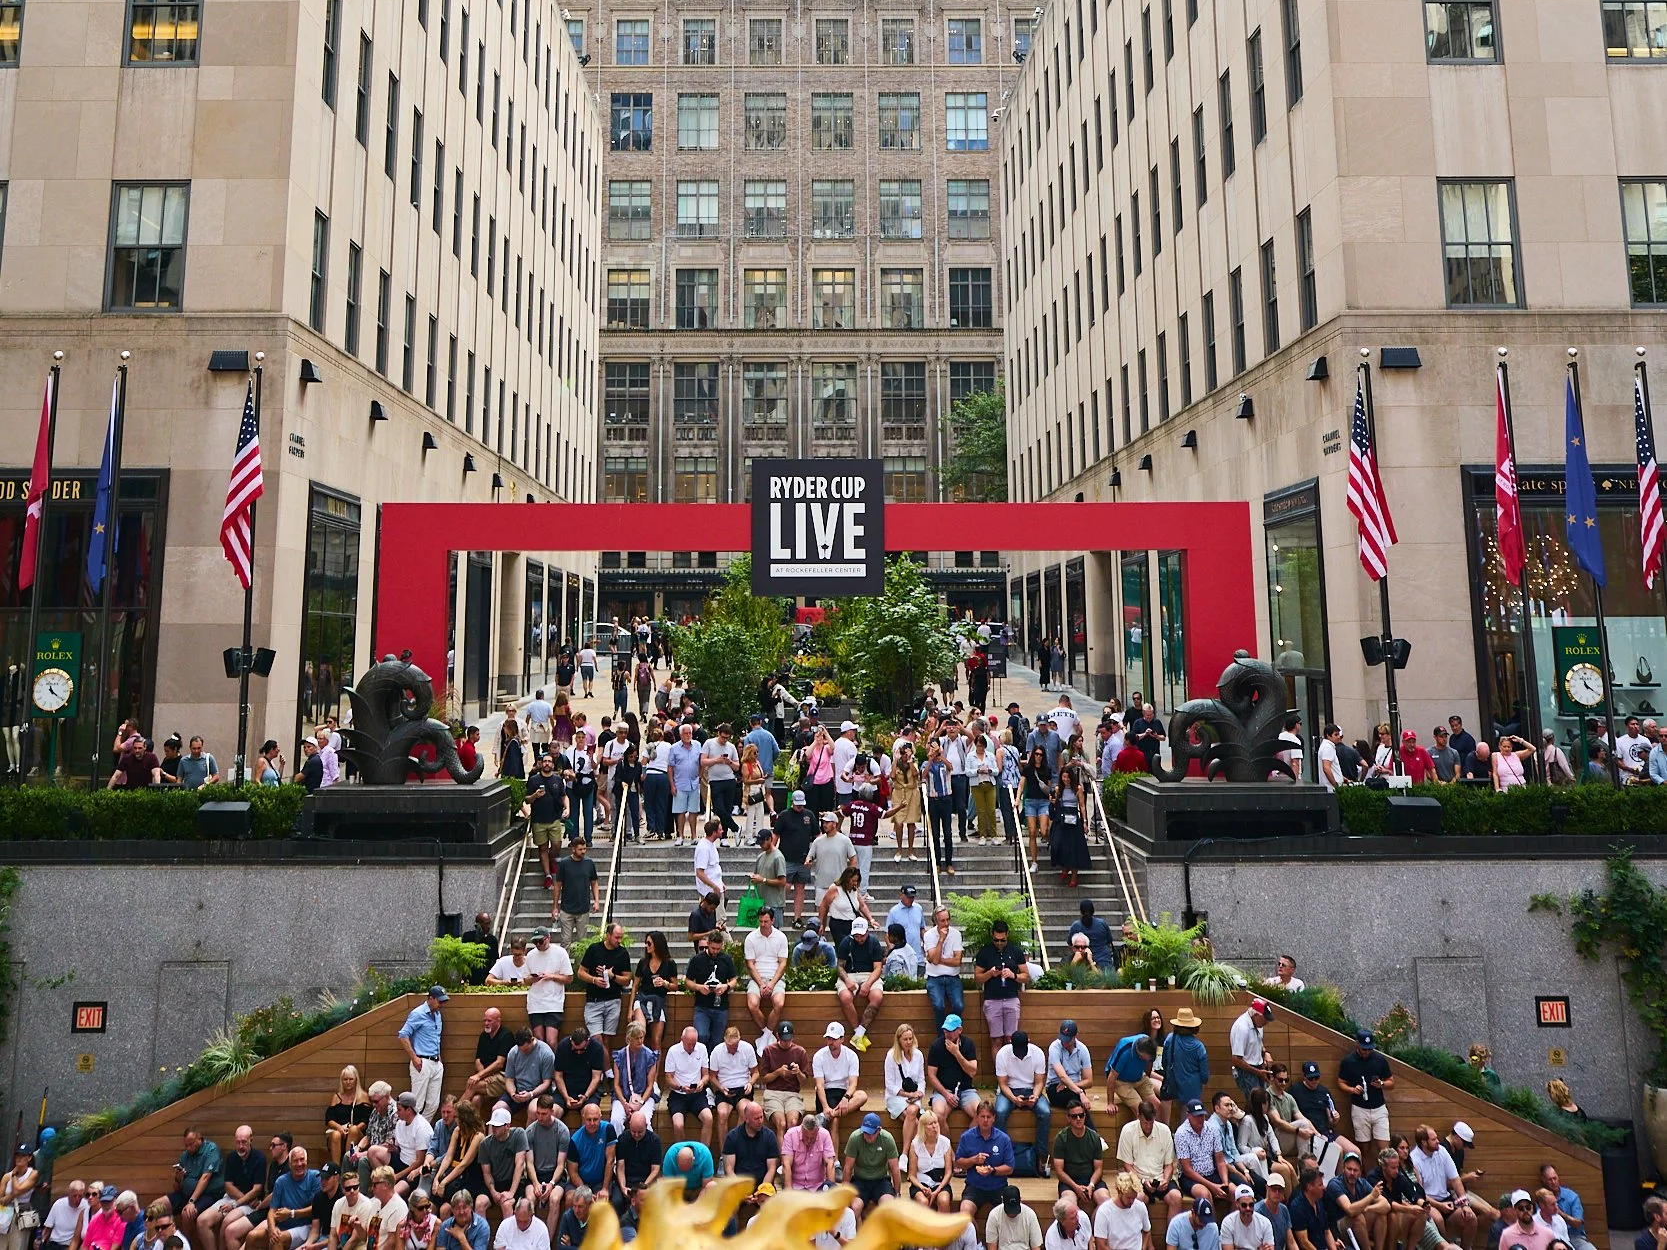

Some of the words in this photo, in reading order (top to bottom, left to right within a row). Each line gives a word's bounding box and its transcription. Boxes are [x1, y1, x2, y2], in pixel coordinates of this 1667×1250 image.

[21, 480, 80, 500] SDER
[770, 476, 828, 499] RYDER
[831, 476, 866, 499] CUP
[1516, 479, 1546, 491] ate
[770, 503, 866, 559] LIVE
[36, 651, 73, 660] ROLEX
[1565, 647, 1600, 655] ROLEX
[78, 1008, 103, 1027] EXIT
[1541, 1002, 1565, 1021] EXIT
